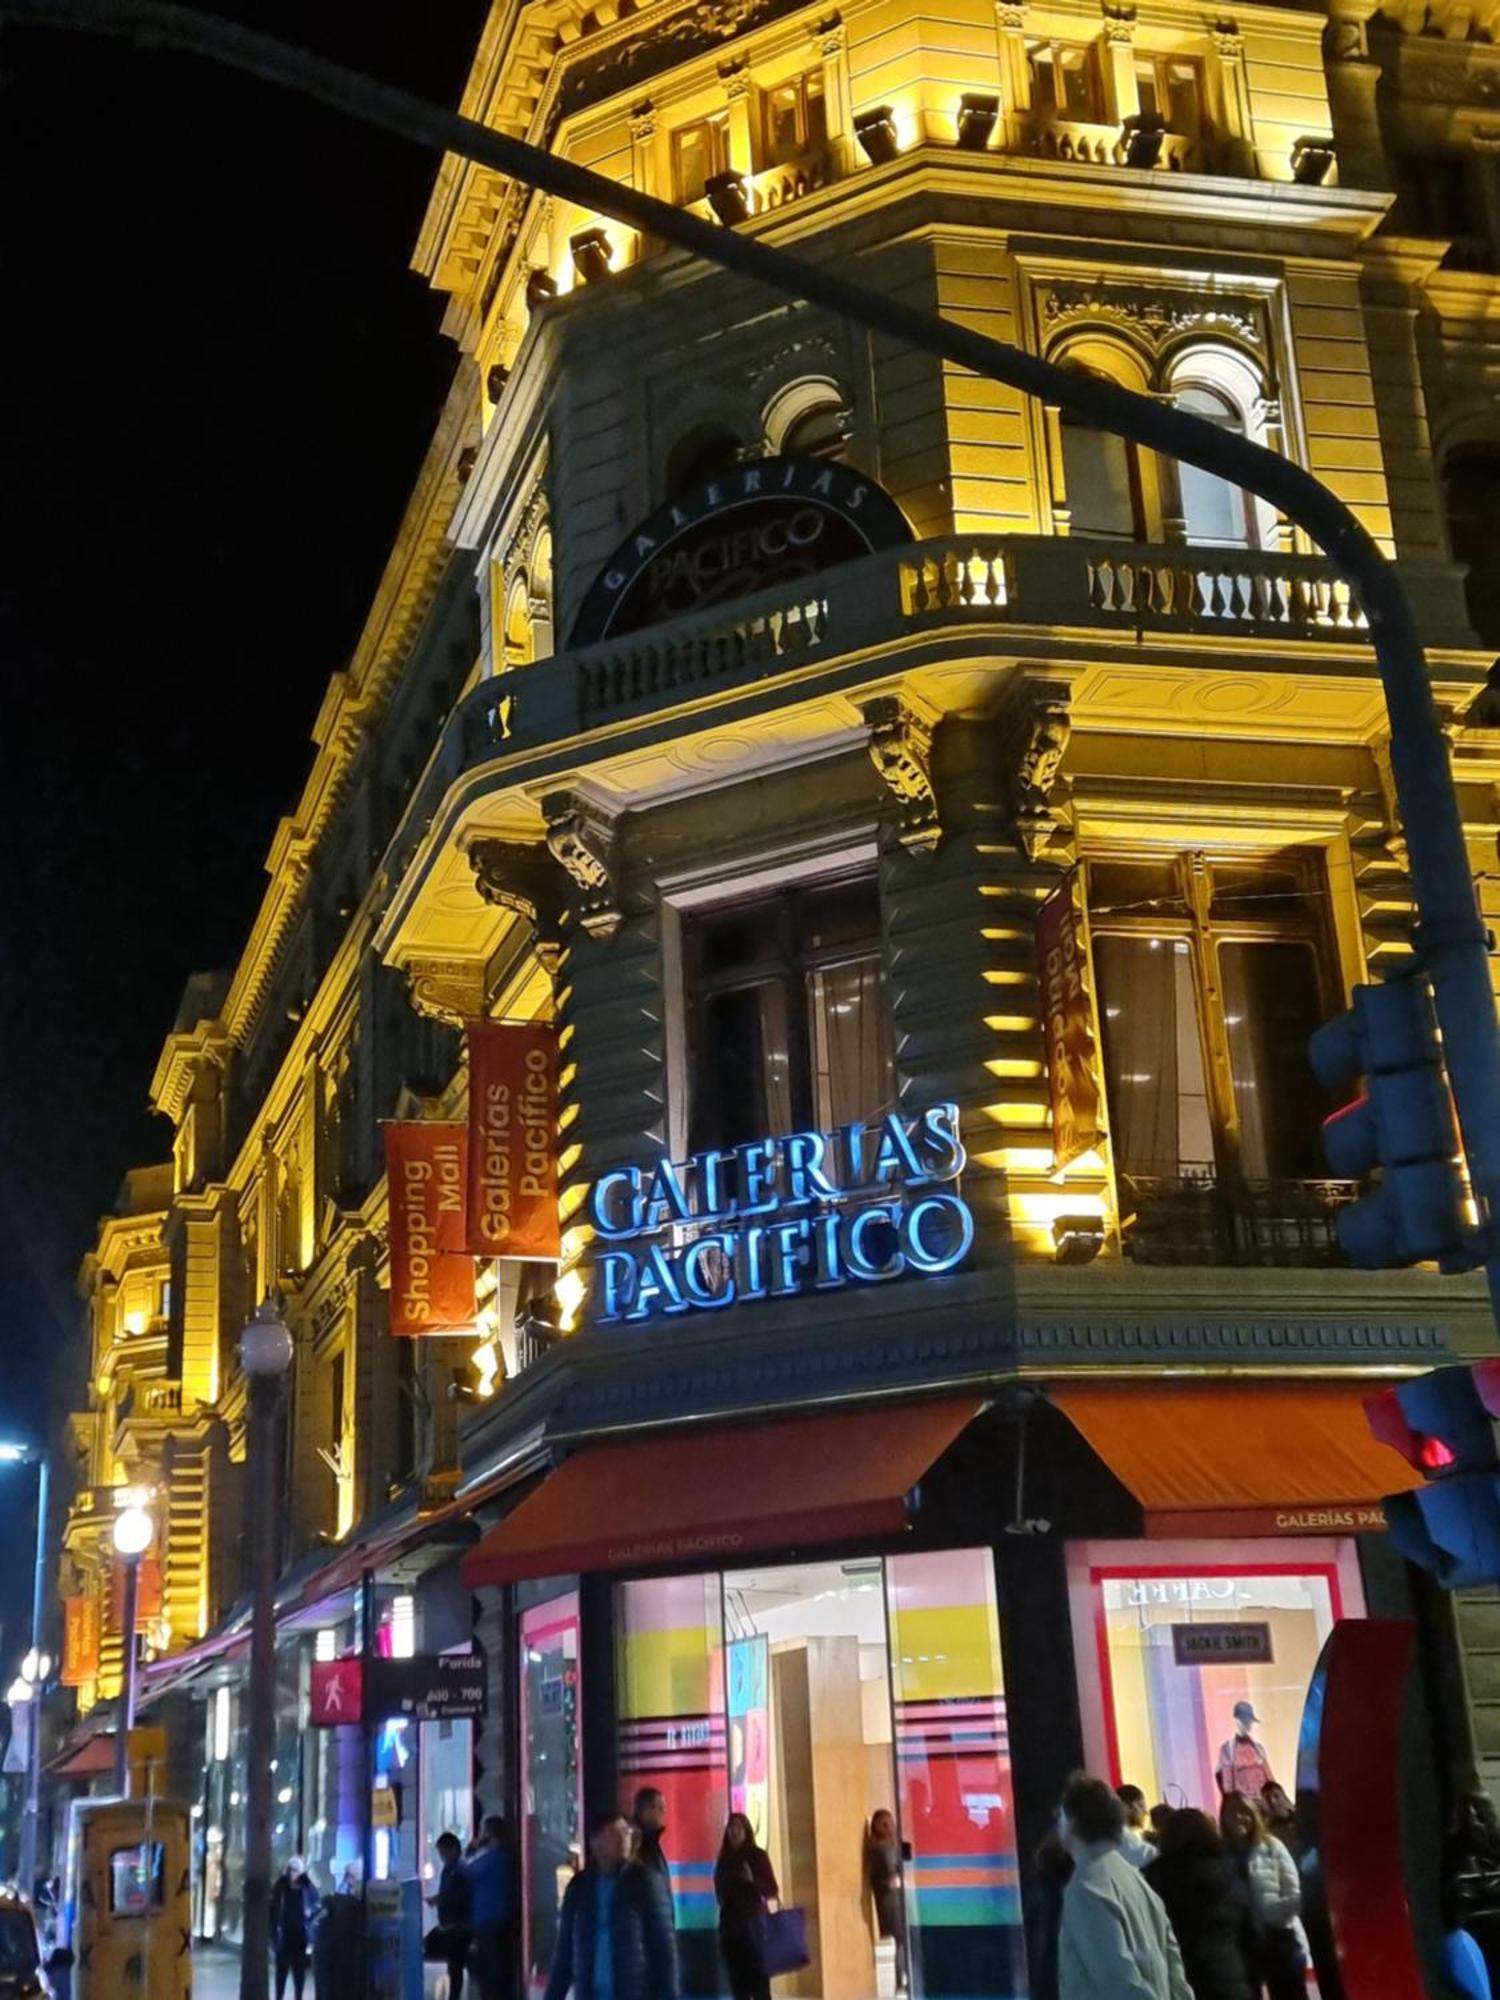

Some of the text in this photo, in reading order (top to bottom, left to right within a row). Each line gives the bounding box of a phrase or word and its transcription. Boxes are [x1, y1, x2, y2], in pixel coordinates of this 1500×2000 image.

[604, 465, 868, 590] GALERIAS
[650, 508, 824, 595] PACIFICO
[436, 1144, 462, 1212] Mall
[478, 1084, 511, 1242] Galerías
[517, 1049, 548, 1197] Pacífico
[590, 1103, 967, 1240] GALERIAS
[403, 1160, 436, 1321] Shopping
[595, 1194, 974, 1324] PACIFICO
[1276, 1510, 1354, 1528] GALERÍAS
